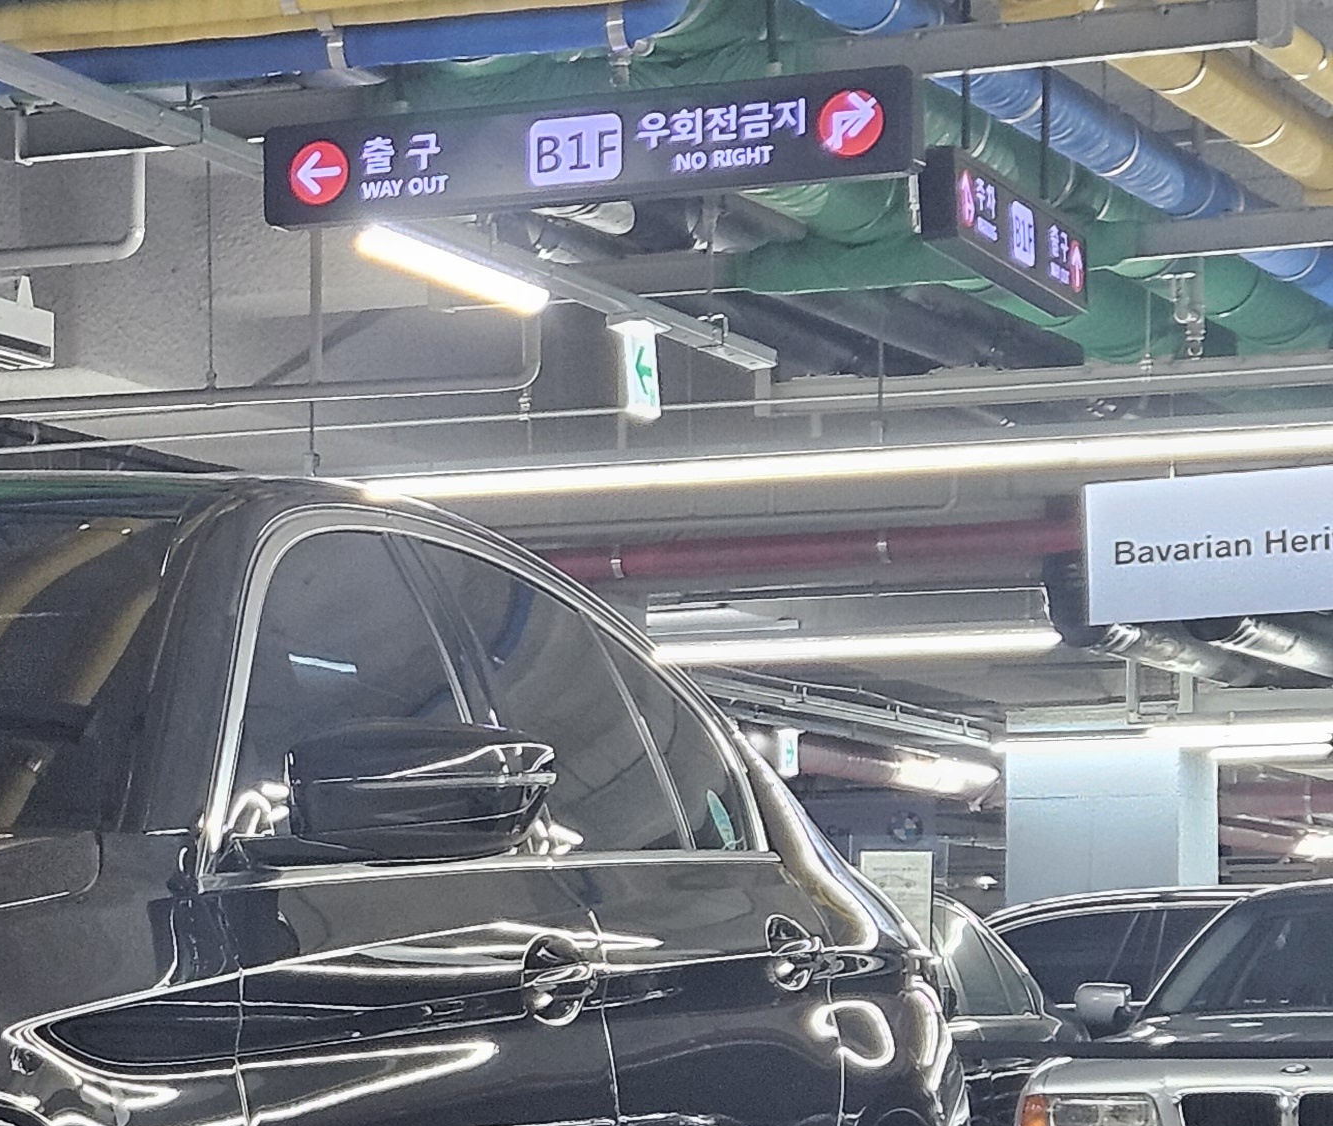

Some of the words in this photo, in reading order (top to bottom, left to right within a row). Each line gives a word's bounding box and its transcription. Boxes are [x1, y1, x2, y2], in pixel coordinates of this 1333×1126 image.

[634, 97, 807, 150] 우회전금지
[535, 128, 619, 174] B1F
[674, 151, 709, 172] NO
[712, 144, 775, 169] RIGHT
[360, 177, 405, 200] WAY
[407, 173, 450, 197] OUT
[1013, 214, 1034, 253] B1F
[1113, 533, 1253, 566] Bavarian
[1264, 525, 1333, 555] Heri
